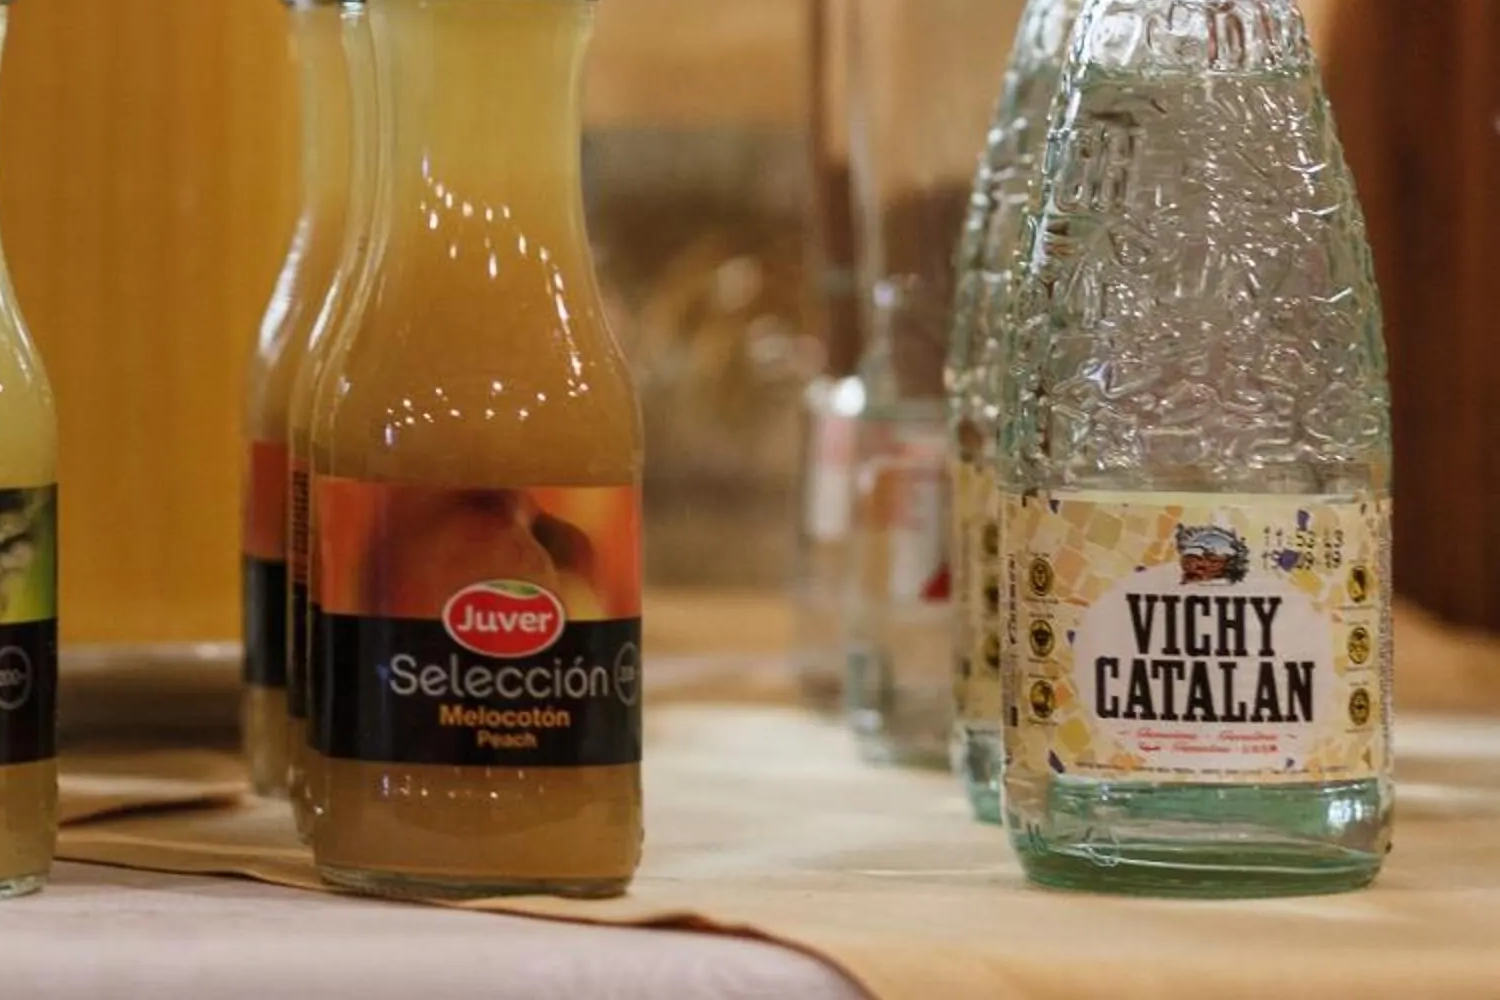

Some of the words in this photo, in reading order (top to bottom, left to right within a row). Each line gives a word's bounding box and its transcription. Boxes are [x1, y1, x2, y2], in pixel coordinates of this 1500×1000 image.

[457, 604, 554, 633] Juver
[1126, 593, 1282, 657] VICHY
[390, 654, 609, 698] Selección
[1094, 656, 1315, 723] CATALAN
[439, 704, 571, 728] Melocotón
[477, 729, 538, 749] Peach
